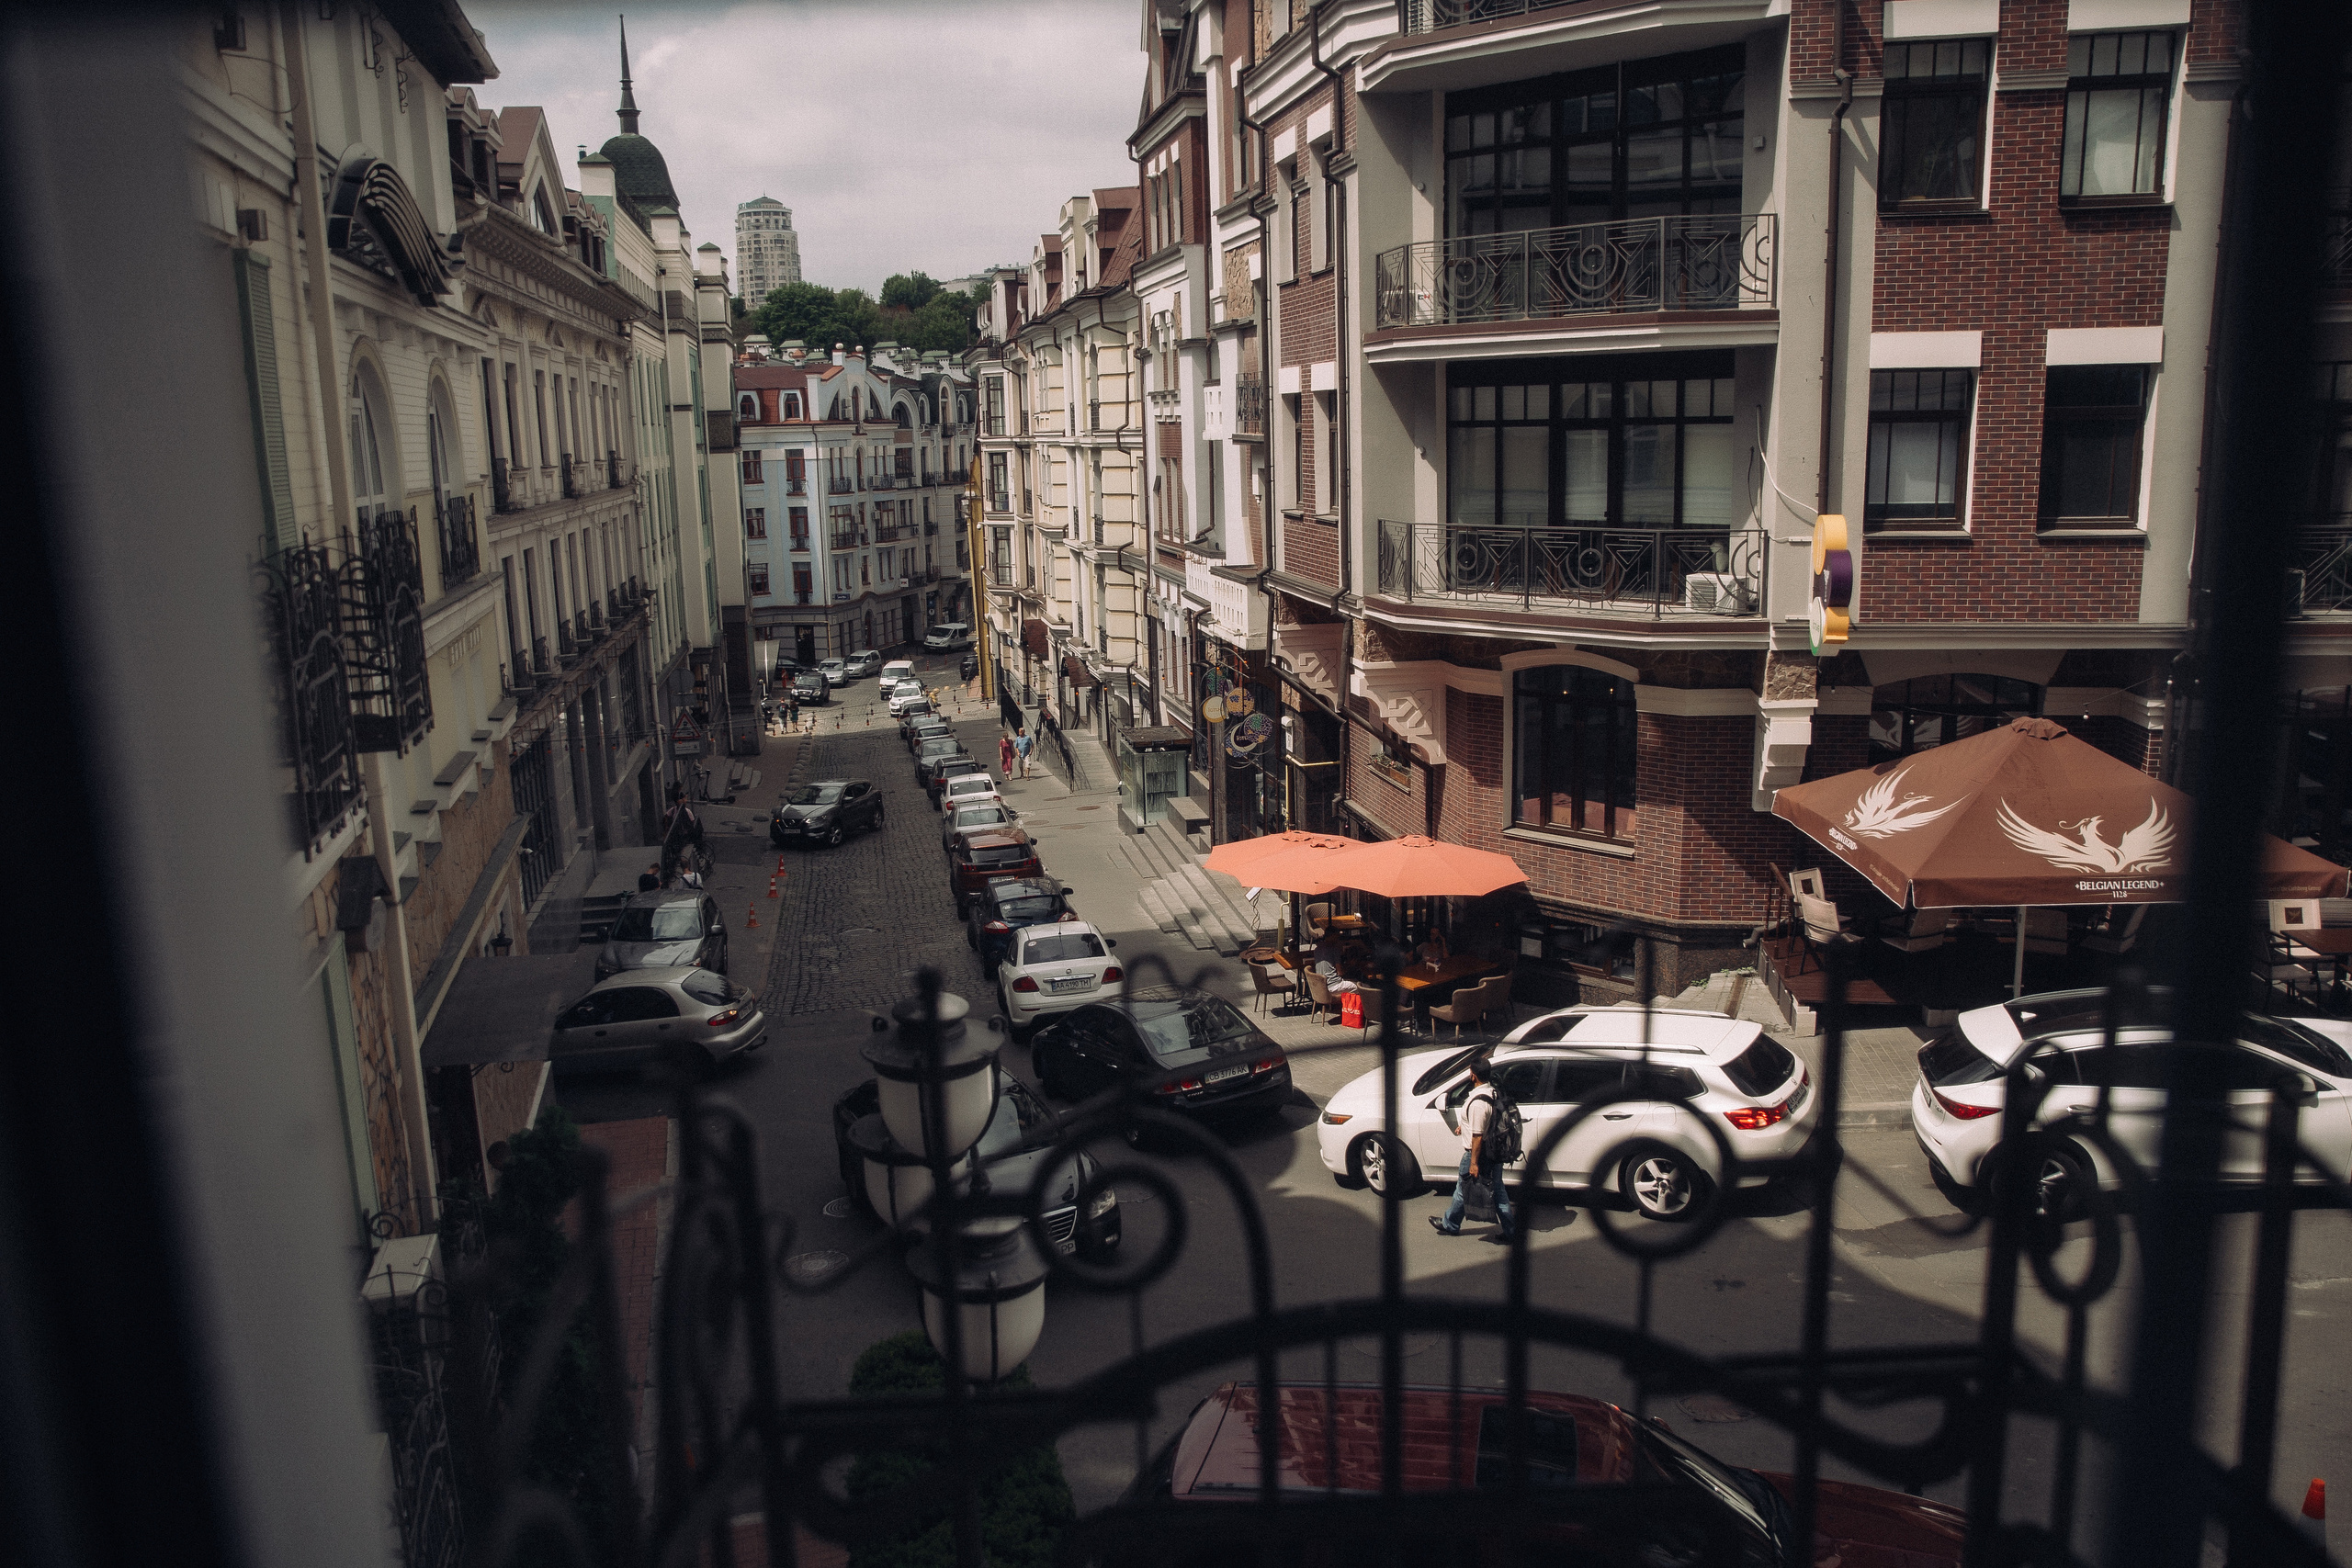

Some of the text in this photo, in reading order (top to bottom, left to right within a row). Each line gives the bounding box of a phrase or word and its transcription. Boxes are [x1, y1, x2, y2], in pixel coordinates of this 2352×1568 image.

[2079, 879, 2159, 891] BELGIAN LEGEND
[2112, 890, 2128, 898] 1128
[1209, 1065, 1247, 1081] CB 3776 AK
